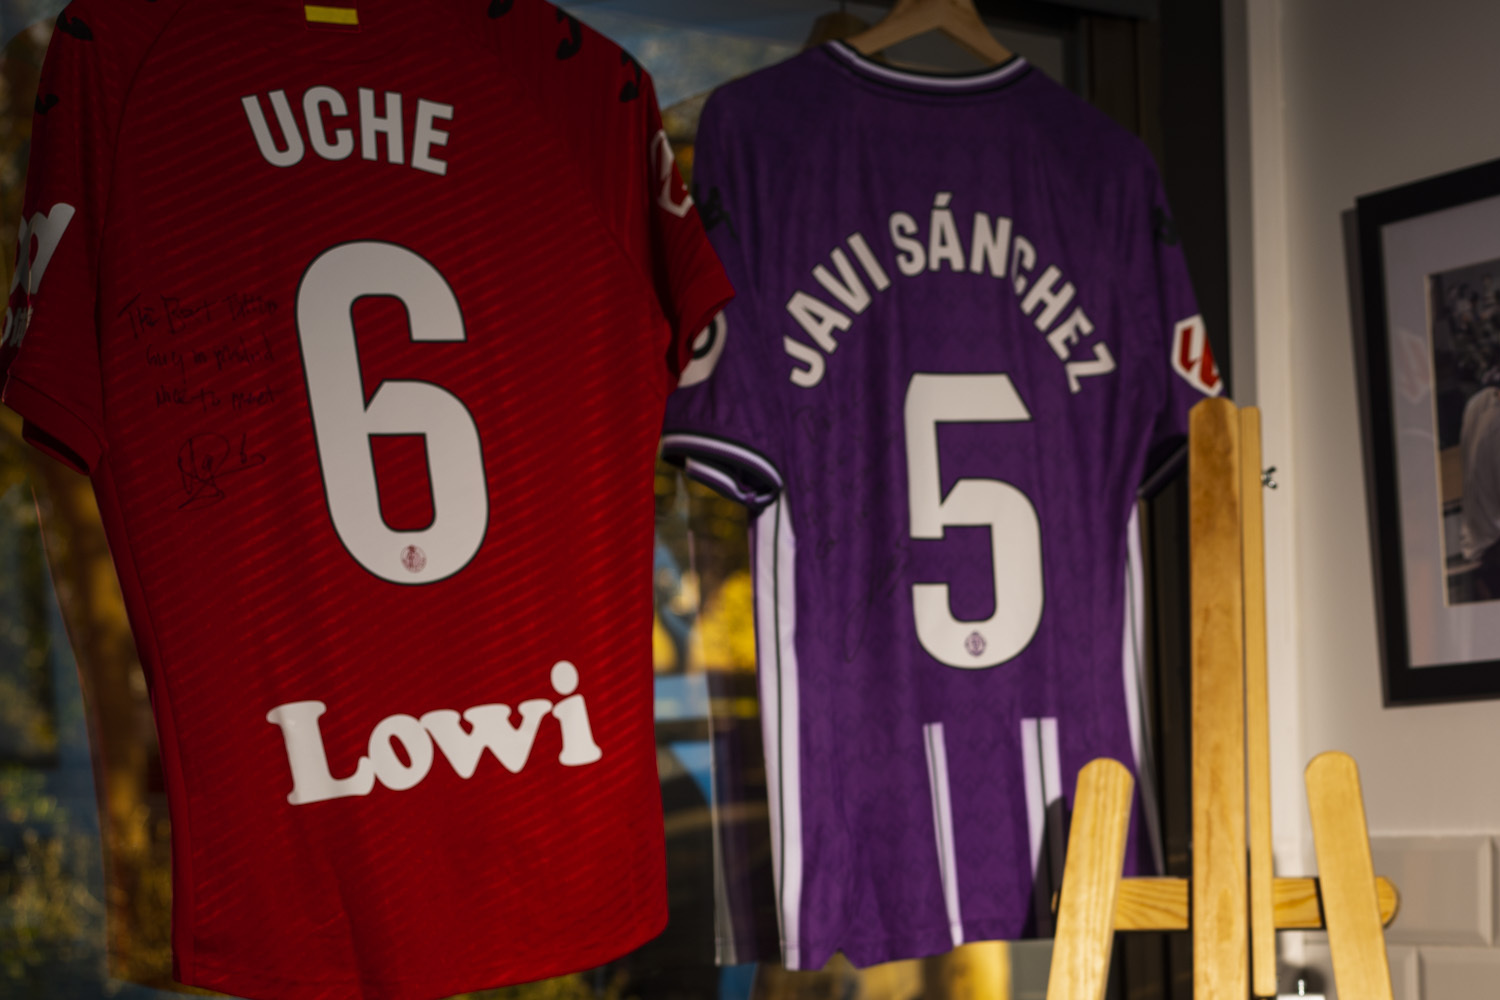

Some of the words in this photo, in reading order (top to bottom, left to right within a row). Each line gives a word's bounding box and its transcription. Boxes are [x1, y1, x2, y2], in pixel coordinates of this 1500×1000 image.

[240, 85, 454, 176] UCHE
[783, 232, 891, 388] JAVI
[889, 192, 1116, 394] SÁNCHEZ
[296, 239, 489, 585] 6
[904, 372, 1045, 670] 5
[265, 660, 602, 806] Lowi
